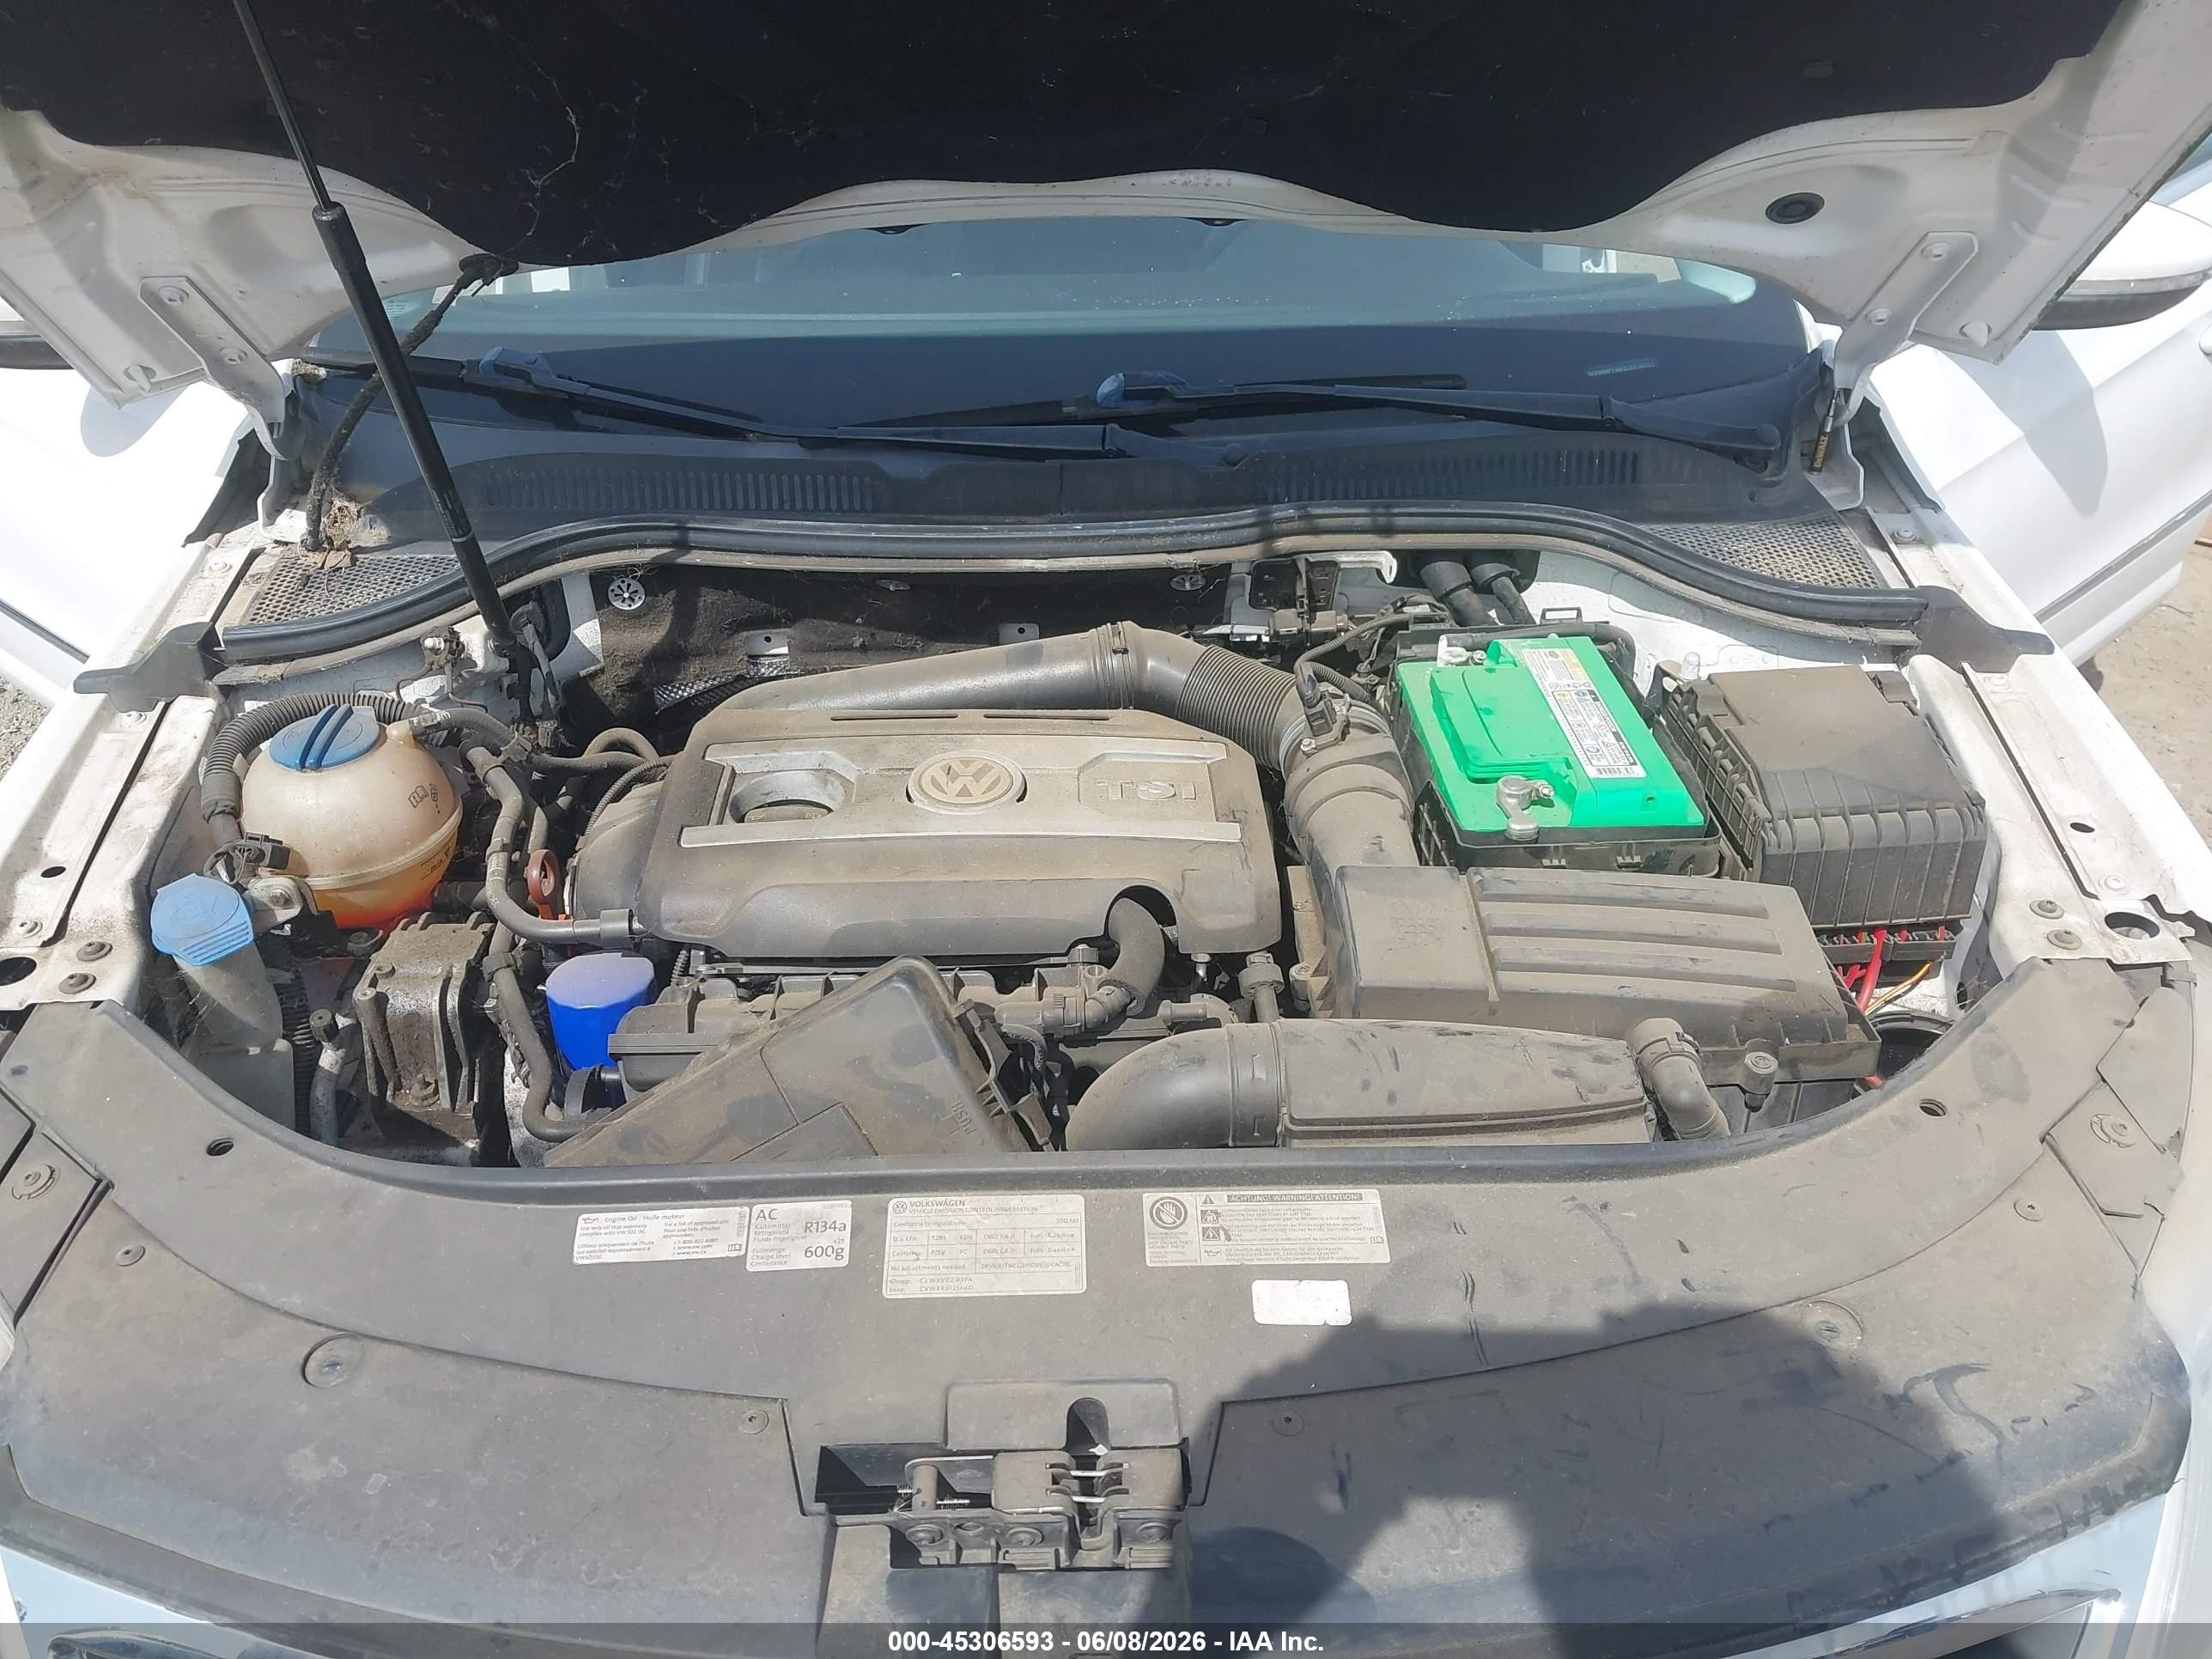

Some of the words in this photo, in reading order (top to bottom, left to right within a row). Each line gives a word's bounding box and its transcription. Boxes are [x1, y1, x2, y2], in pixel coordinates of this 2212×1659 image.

[1094, 779, 1197, 800] TSI
[1316, 1193, 1360, 1201] ATTENTION!
[756, 1208, 779, 1221] AC
[804, 1220, 847, 1233] R134a
[804, 1244, 844, 1261] 600g
